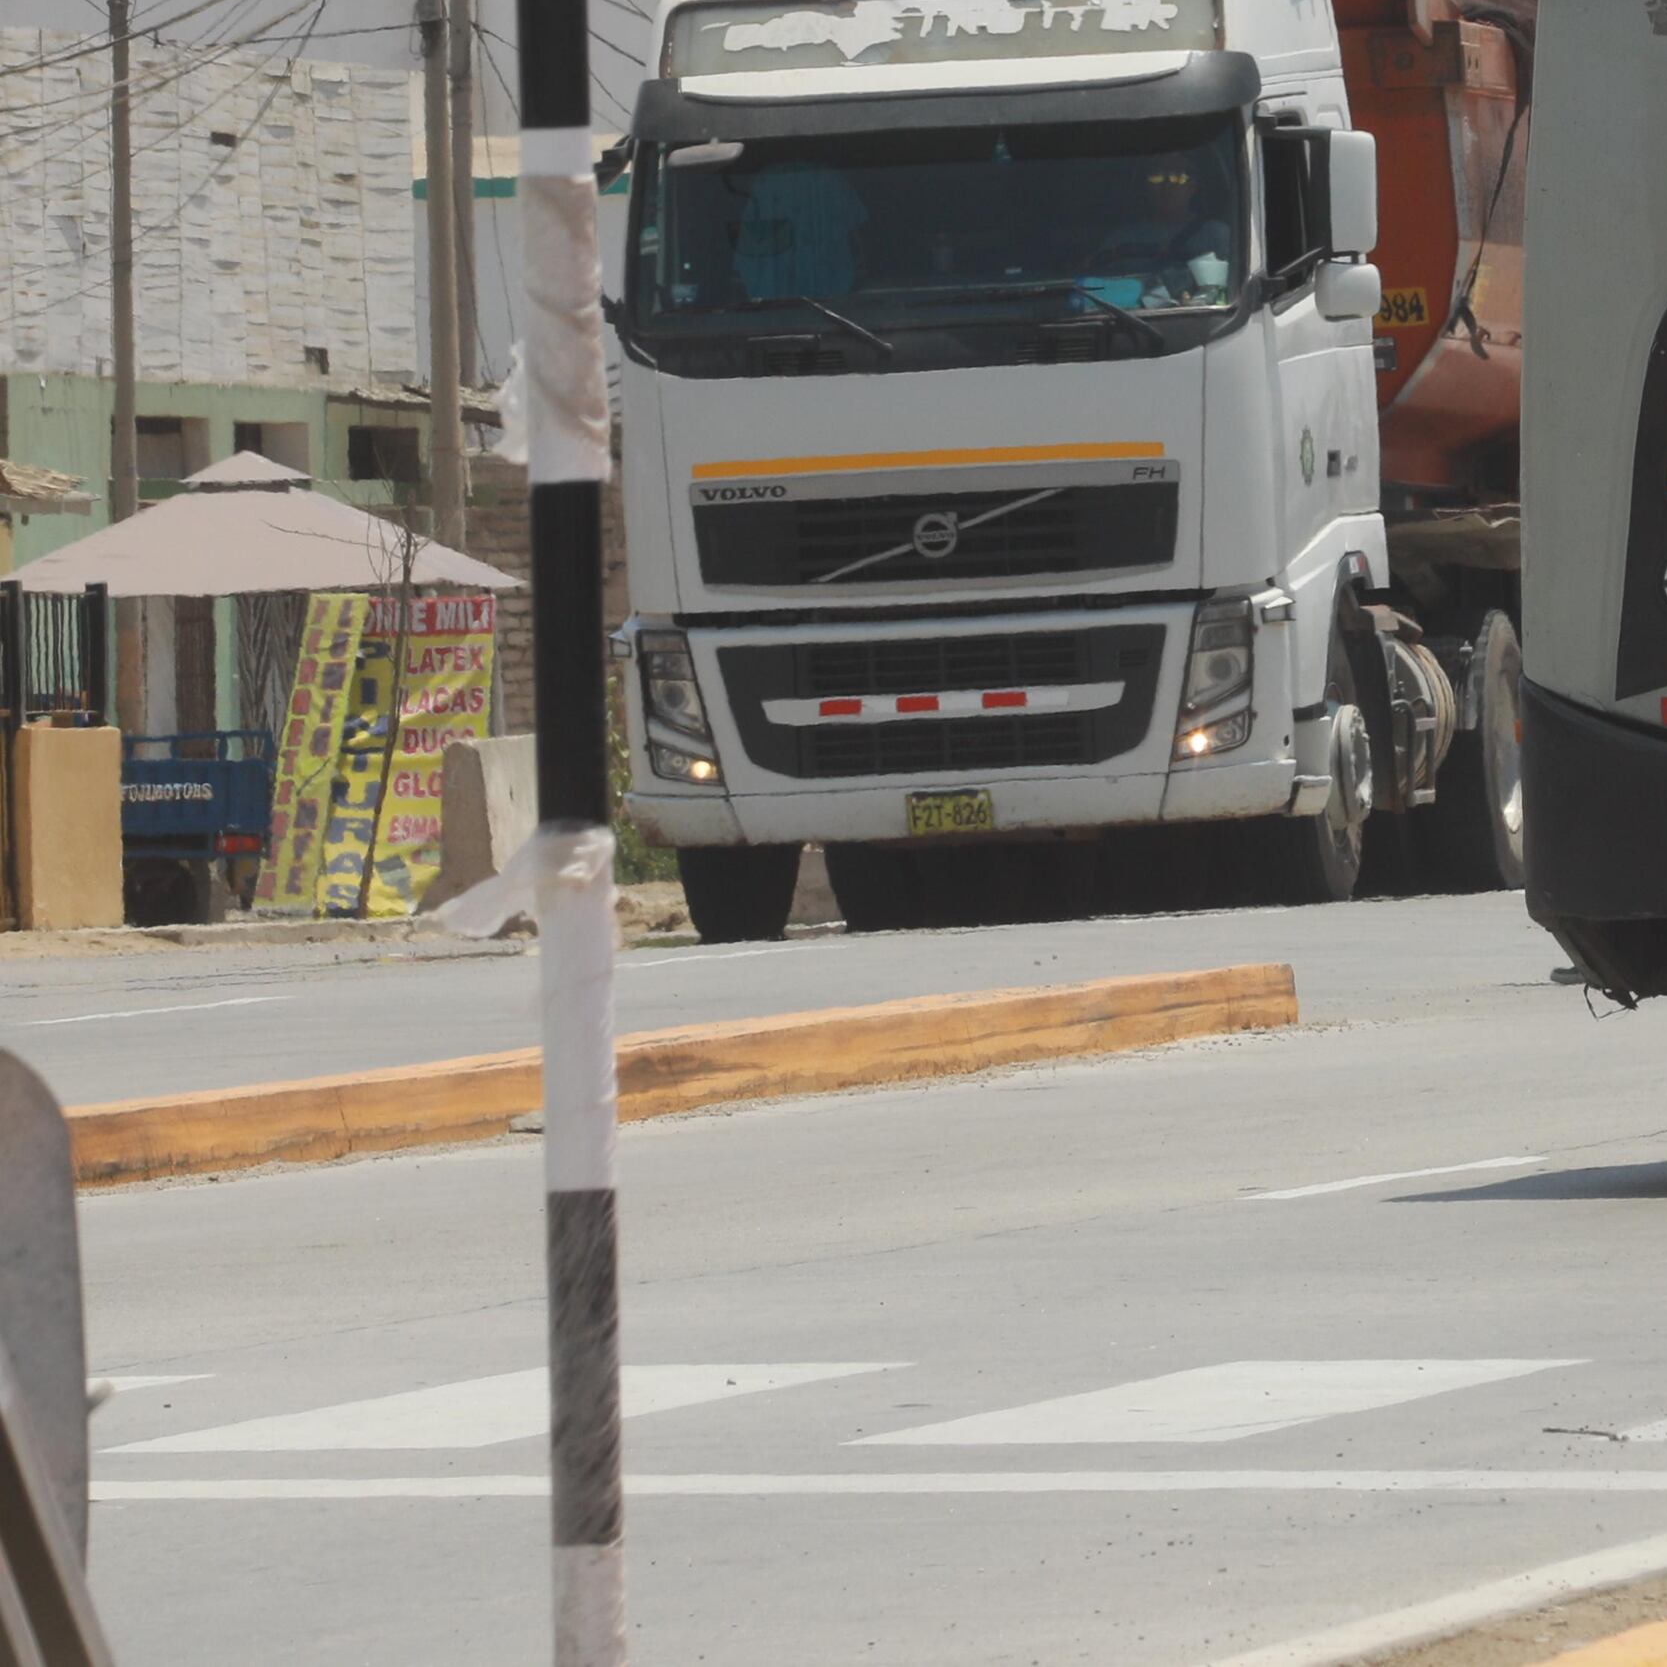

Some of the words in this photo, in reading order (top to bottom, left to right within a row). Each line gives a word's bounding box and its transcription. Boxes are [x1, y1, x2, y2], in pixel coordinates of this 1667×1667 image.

[1132, 466, 1166, 479] FH
[701, 484, 786, 502] VOLVO
[406, 645, 484, 674] LATEX
[401, 687, 484, 715] LACAS
[387, 815, 440, 843] ESMA
